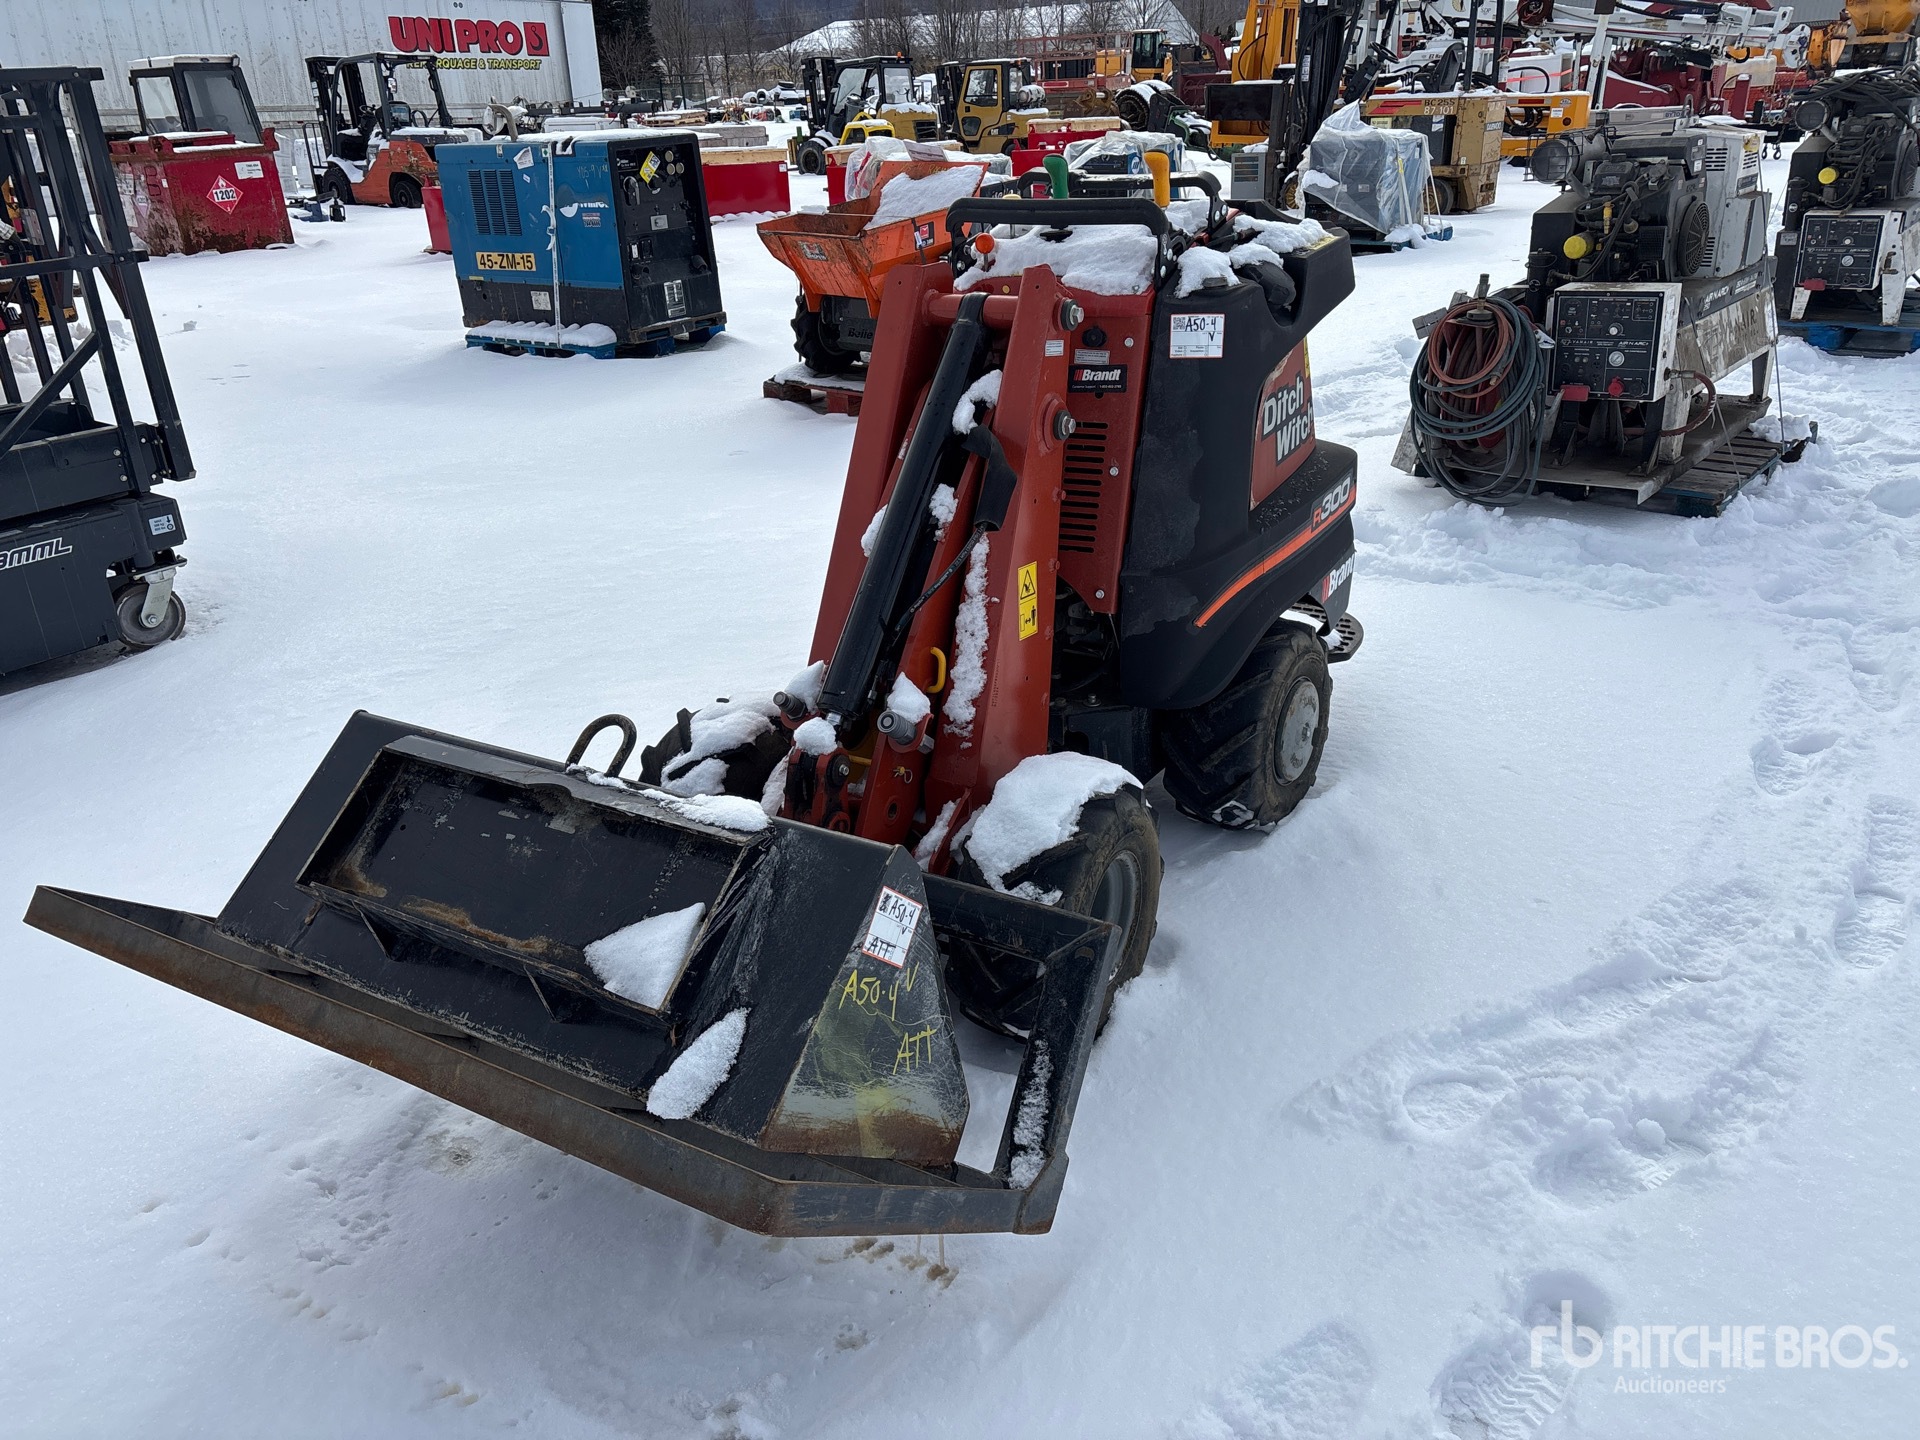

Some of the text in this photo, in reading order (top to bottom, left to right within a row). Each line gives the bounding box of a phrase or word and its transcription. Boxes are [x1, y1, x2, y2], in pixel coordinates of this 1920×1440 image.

[478, 58, 486, 69] &
[487, 58, 541, 70] TRANSPORT
[214, 189, 236, 201] 1202
[479, 253, 534, 271] 45-ZM-15
[1184, 316, 1217, 332] A50-4
[1081, 369, 1121, 381] Brandt
[1262, 375, 1304, 436] Ditch
[1276, 401, 1314, 462] Witch
[1312, 476, 1351, 528] R300
[867, 936, 896, 959] ATT
[892, 1024, 937, 1075] ATT
